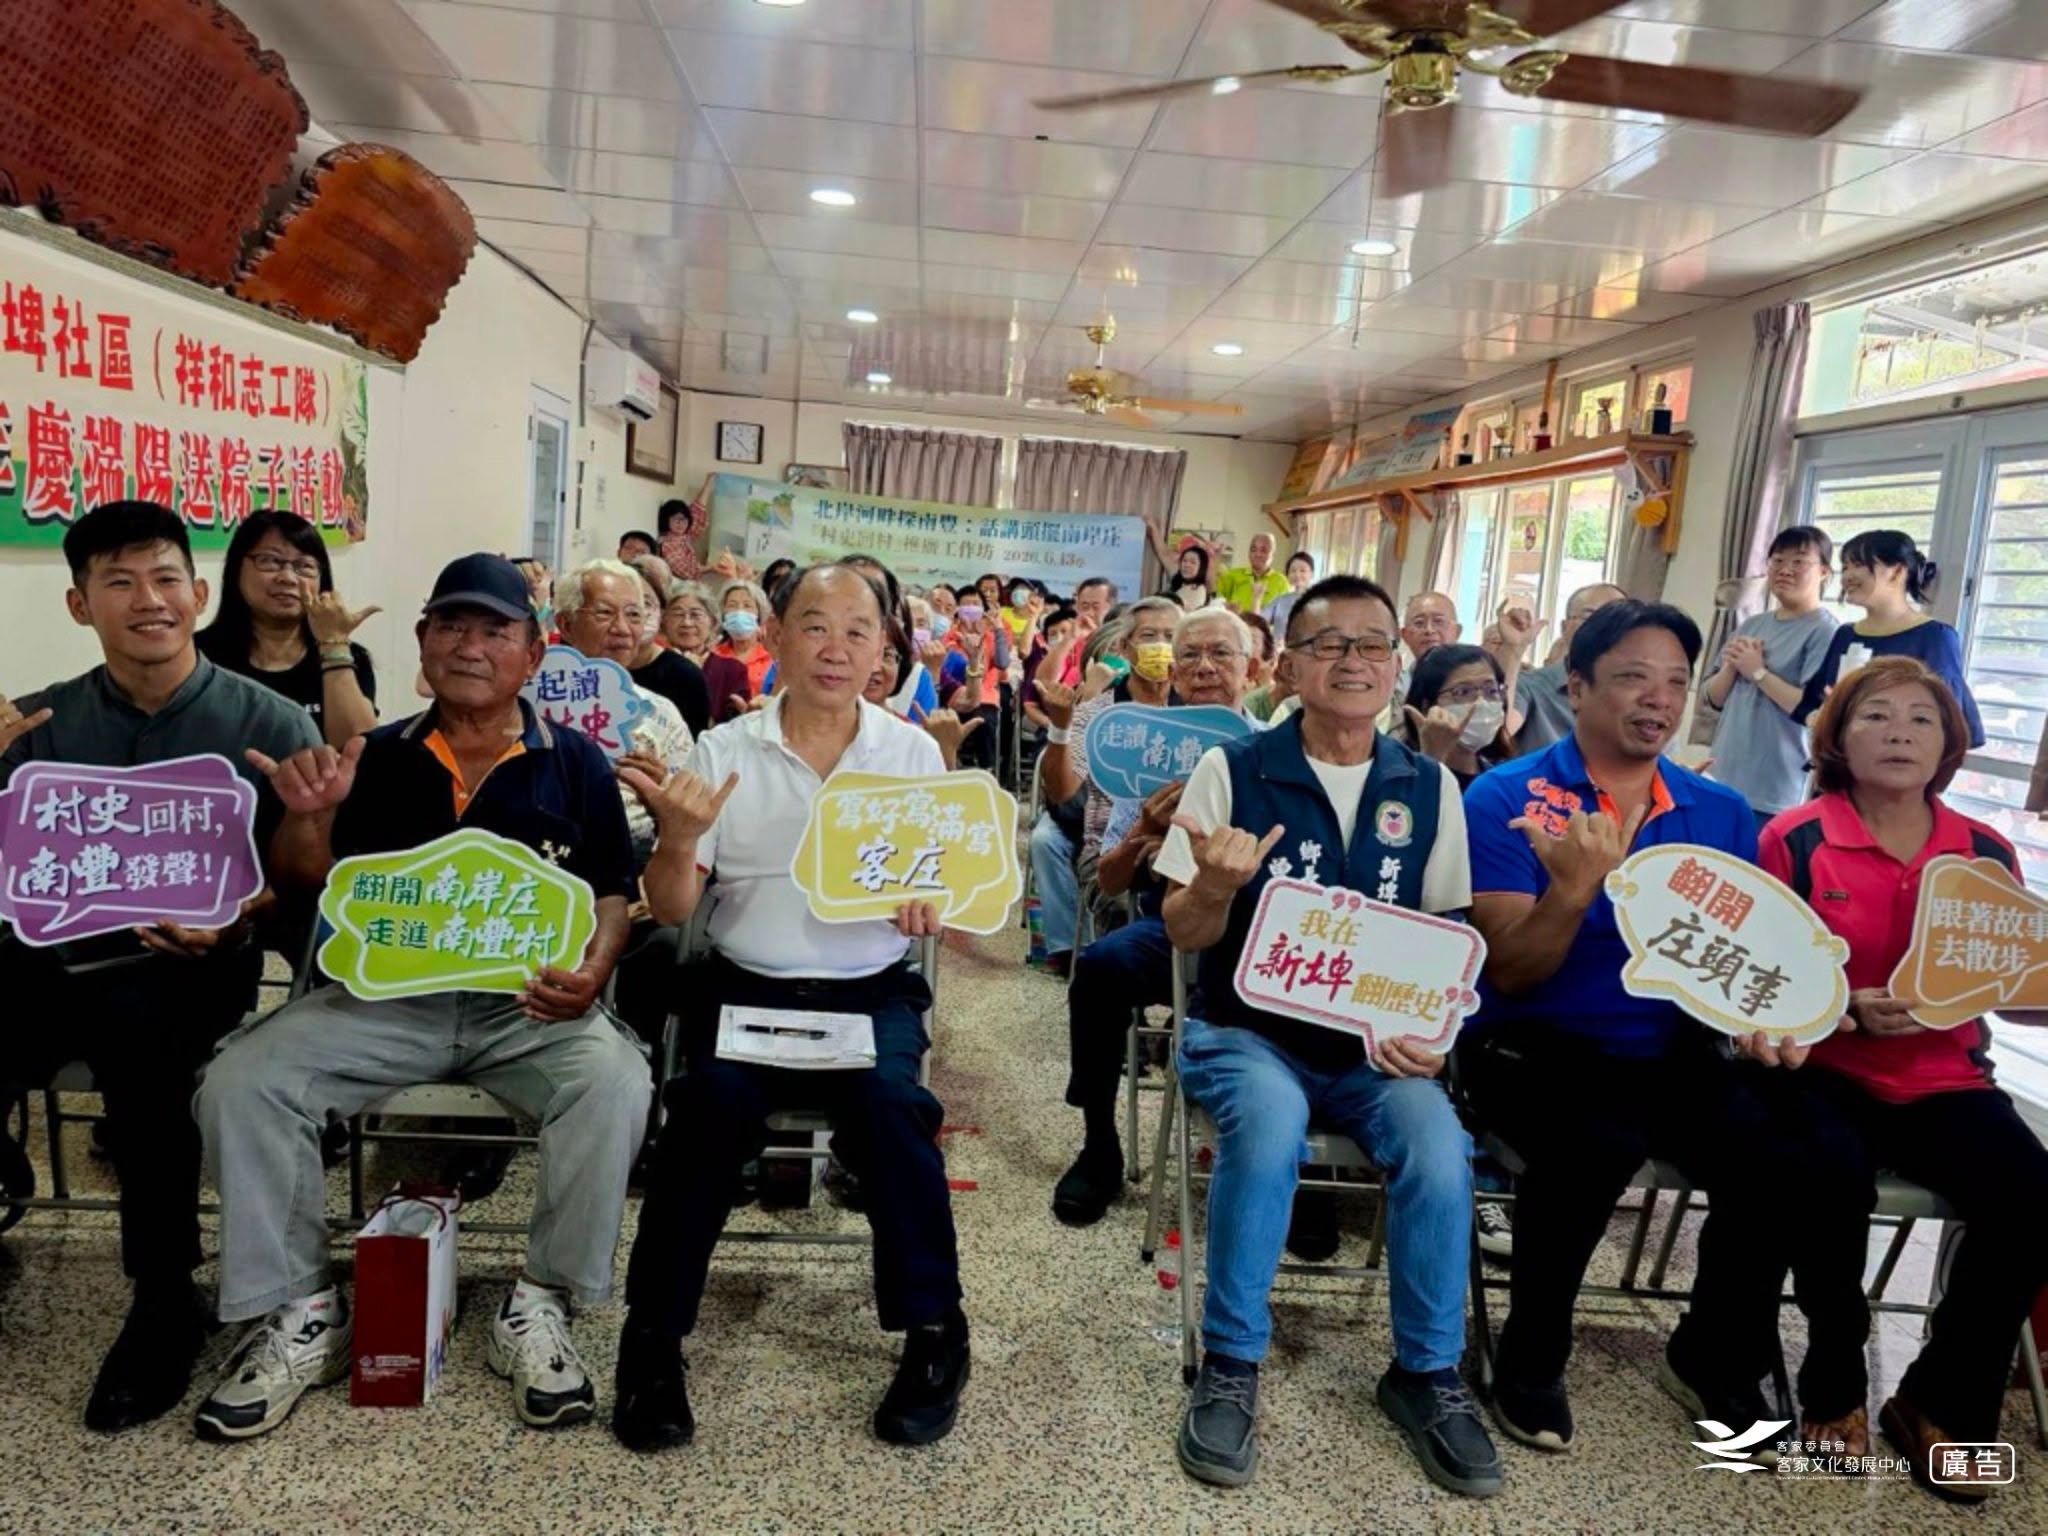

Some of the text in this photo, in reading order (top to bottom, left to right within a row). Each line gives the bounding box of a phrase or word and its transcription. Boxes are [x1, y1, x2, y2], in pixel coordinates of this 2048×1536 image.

[851, 834, 947, 893] 客庄
[1667, 856, 1755, 932] 翻開
[1299, 908, 1363, 947] 我在
[1934, 934, 2031, 977] 去散步
[1647, 911, 1792, 1018] 庄頭事
